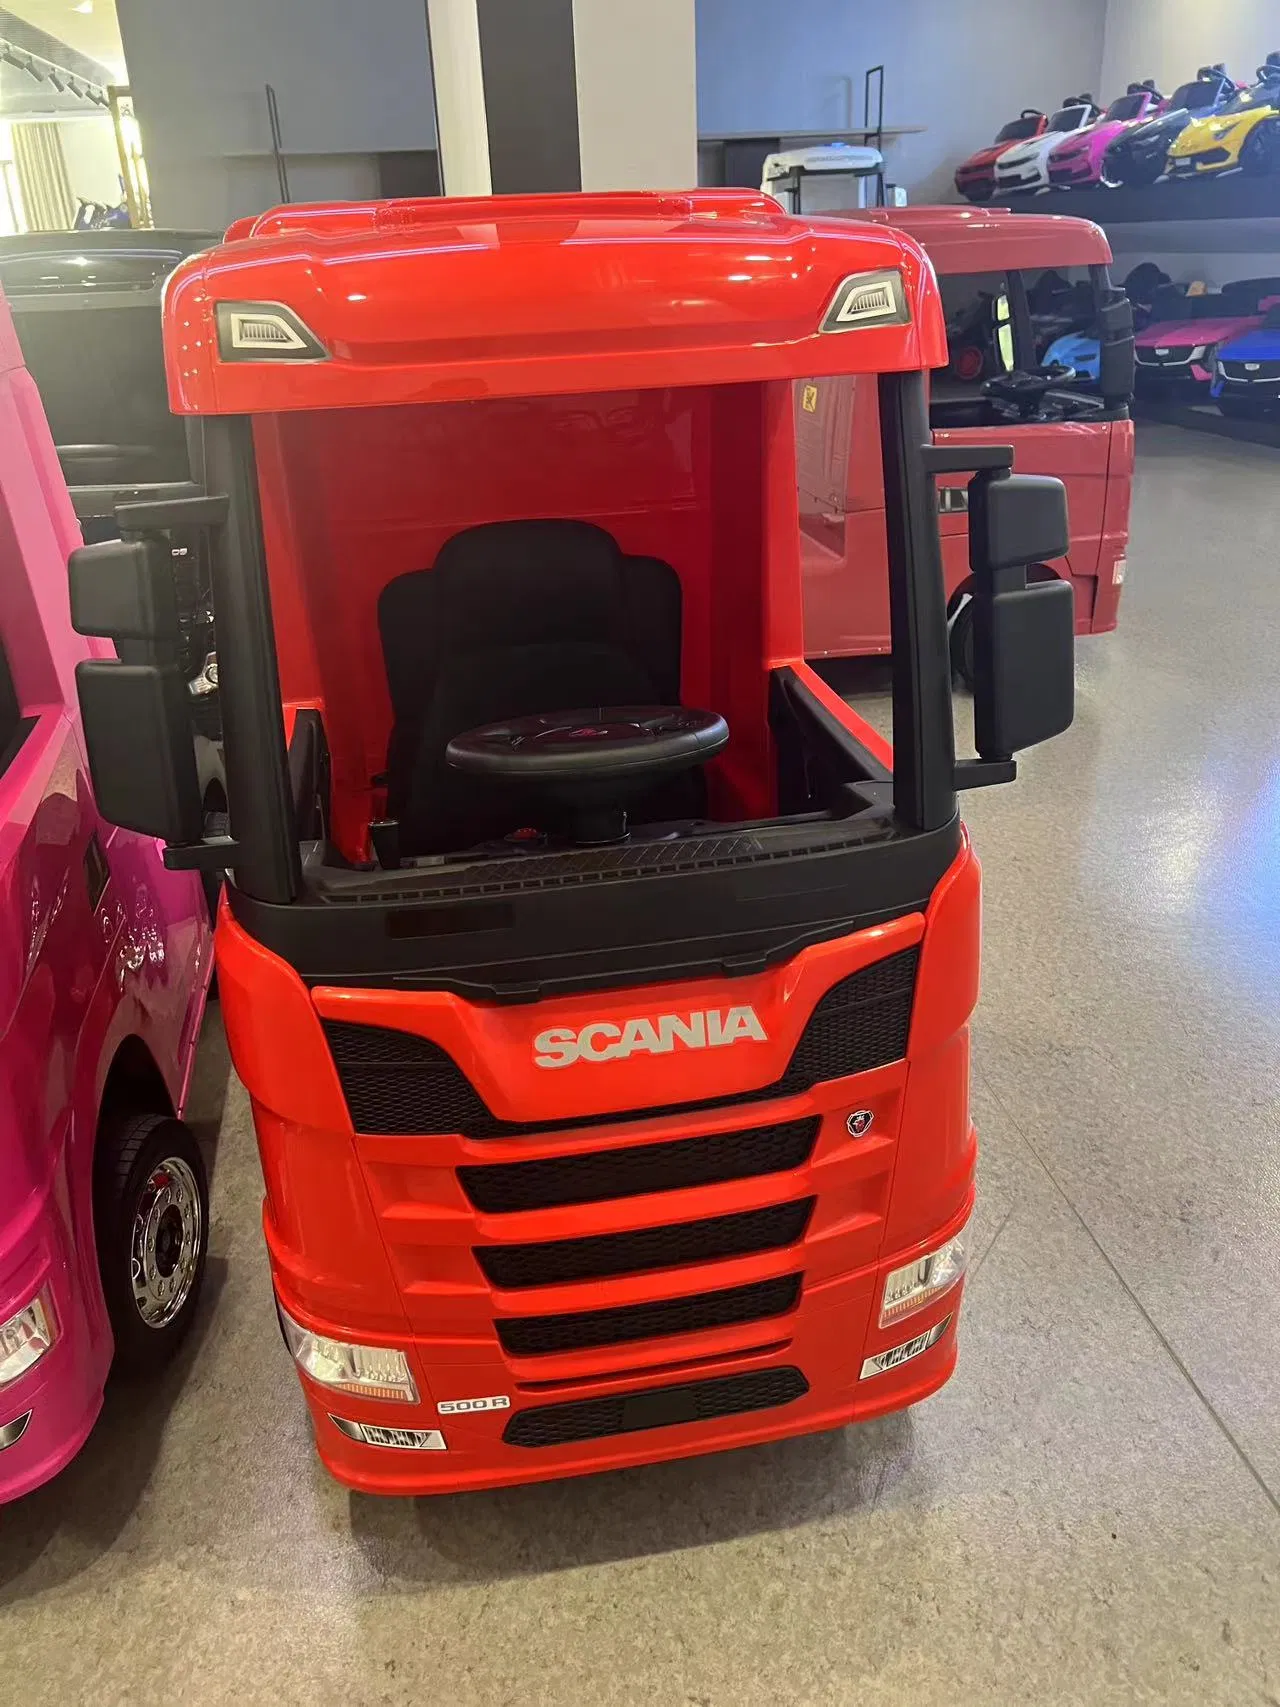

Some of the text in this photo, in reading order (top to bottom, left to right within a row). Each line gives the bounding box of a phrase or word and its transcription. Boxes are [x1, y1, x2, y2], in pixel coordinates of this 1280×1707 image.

[534, 1005, 768, 1068] SCANIA
[440, 1397, 508, 1412] 500 R
